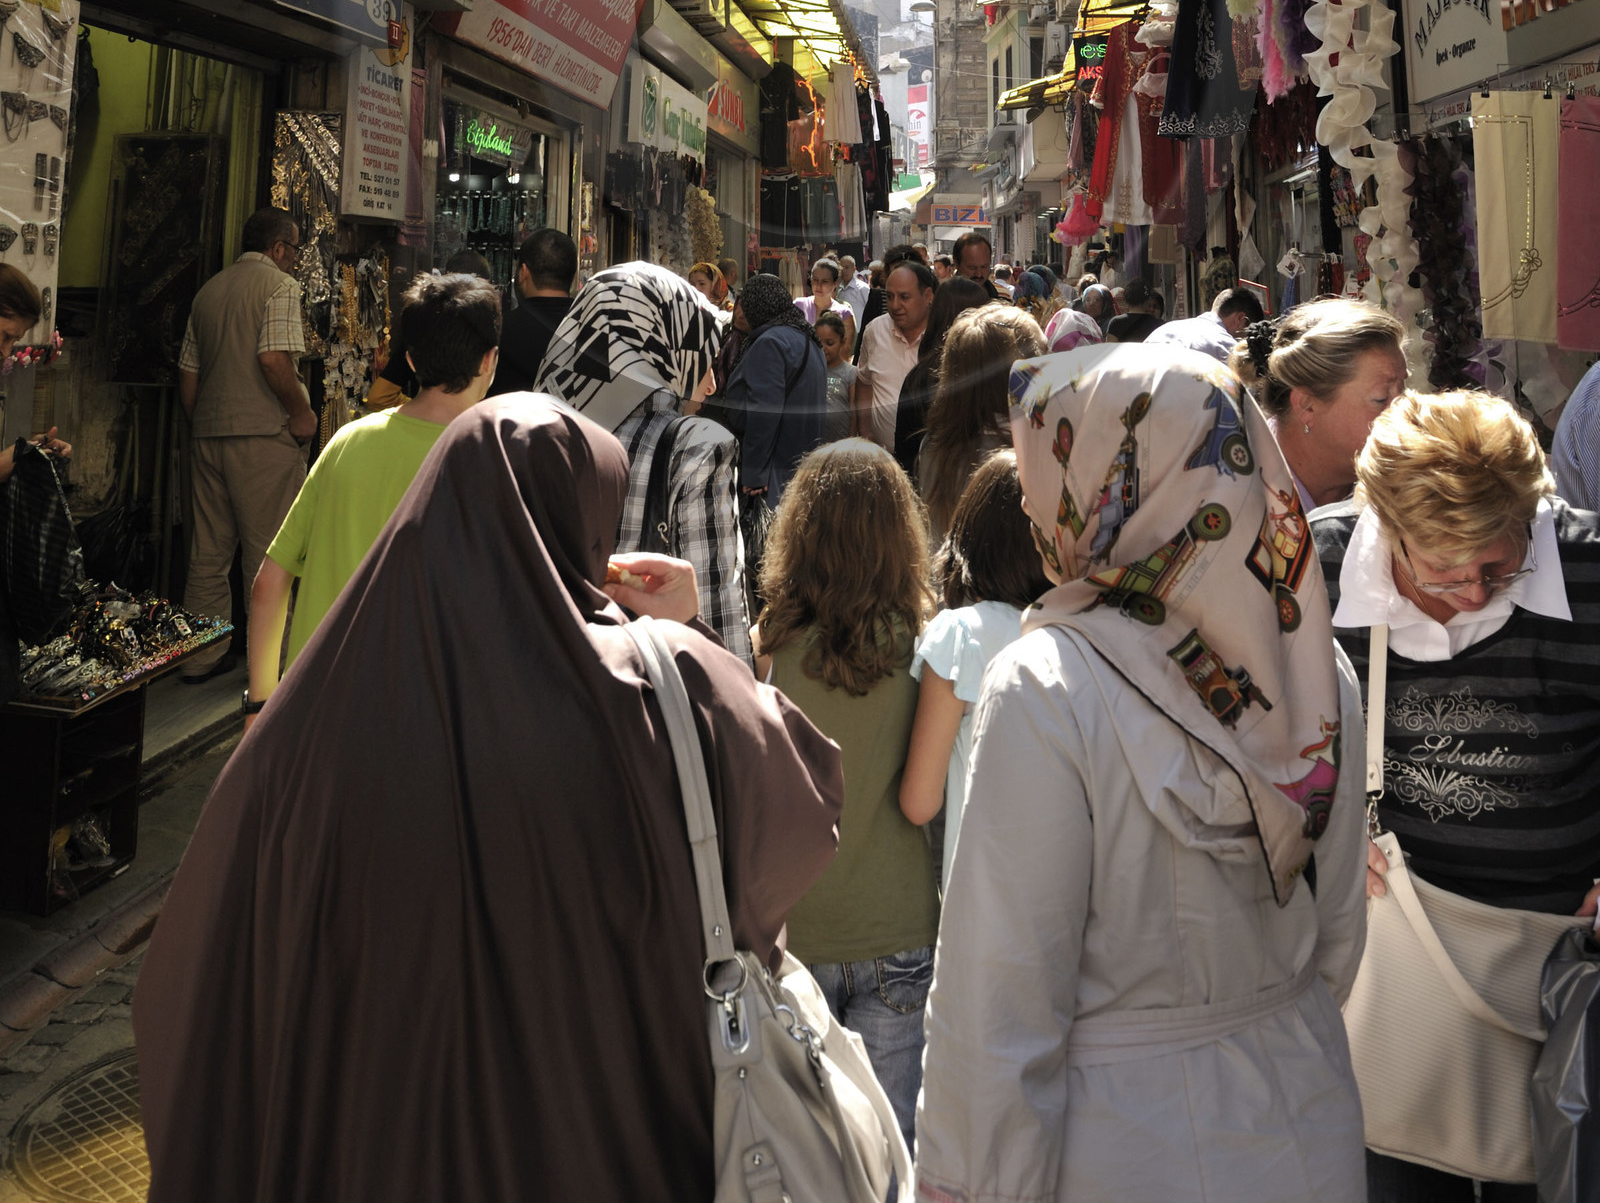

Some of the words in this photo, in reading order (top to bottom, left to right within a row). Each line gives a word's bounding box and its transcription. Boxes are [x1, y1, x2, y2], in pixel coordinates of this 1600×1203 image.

[556, 2, 581, 33] TAKI
[486, 16, 537, 59] 1956'DAN
[366, 64, 404, 93] TİCARET
